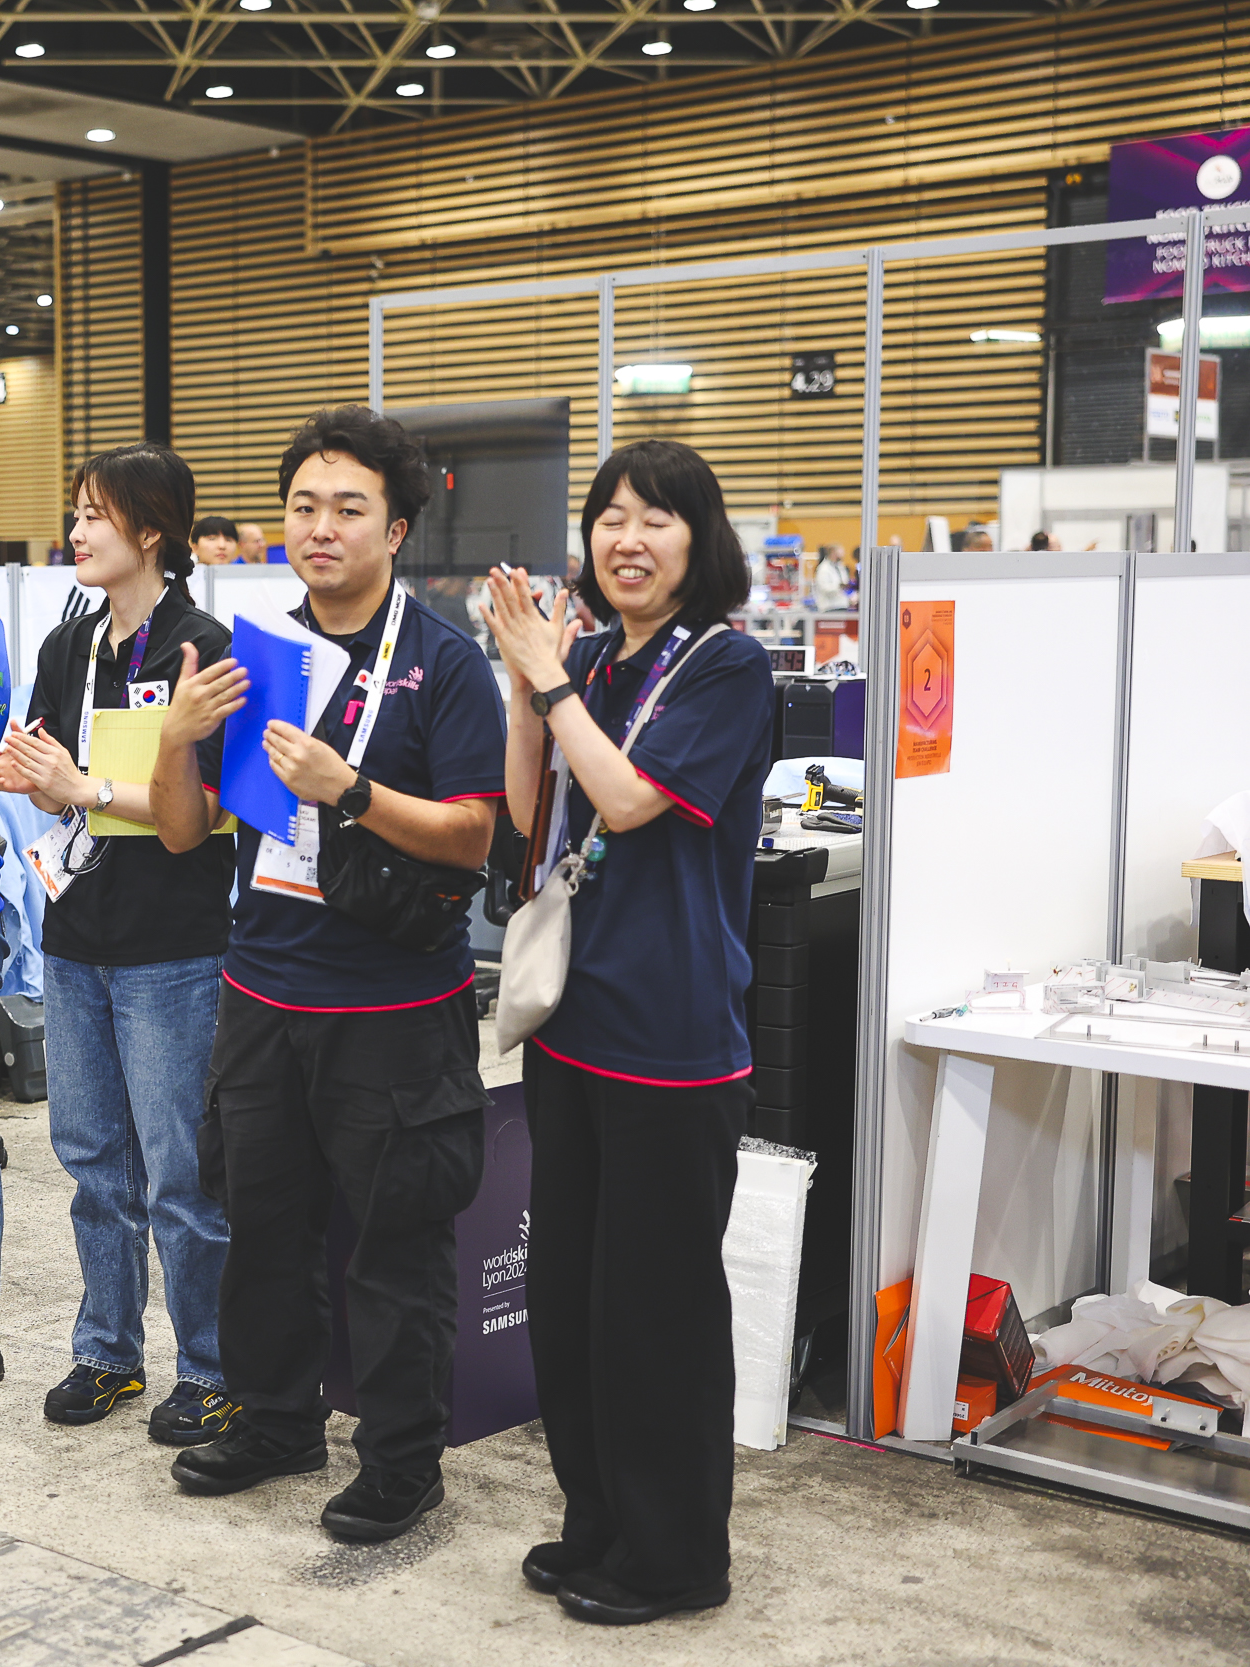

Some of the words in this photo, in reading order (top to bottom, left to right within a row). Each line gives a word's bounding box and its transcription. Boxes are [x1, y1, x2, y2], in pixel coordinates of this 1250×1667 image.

[924, 668, 932, 691] 2
[81, 711, 89, 743] SAMSUNG
[358, 709, 374, 743] SAMSUNG
[483, 1243, 528, 1271] worldski
[482, 1261, 527, 1290] Lyon202
[482, 1303, 504, 1314] Presented
